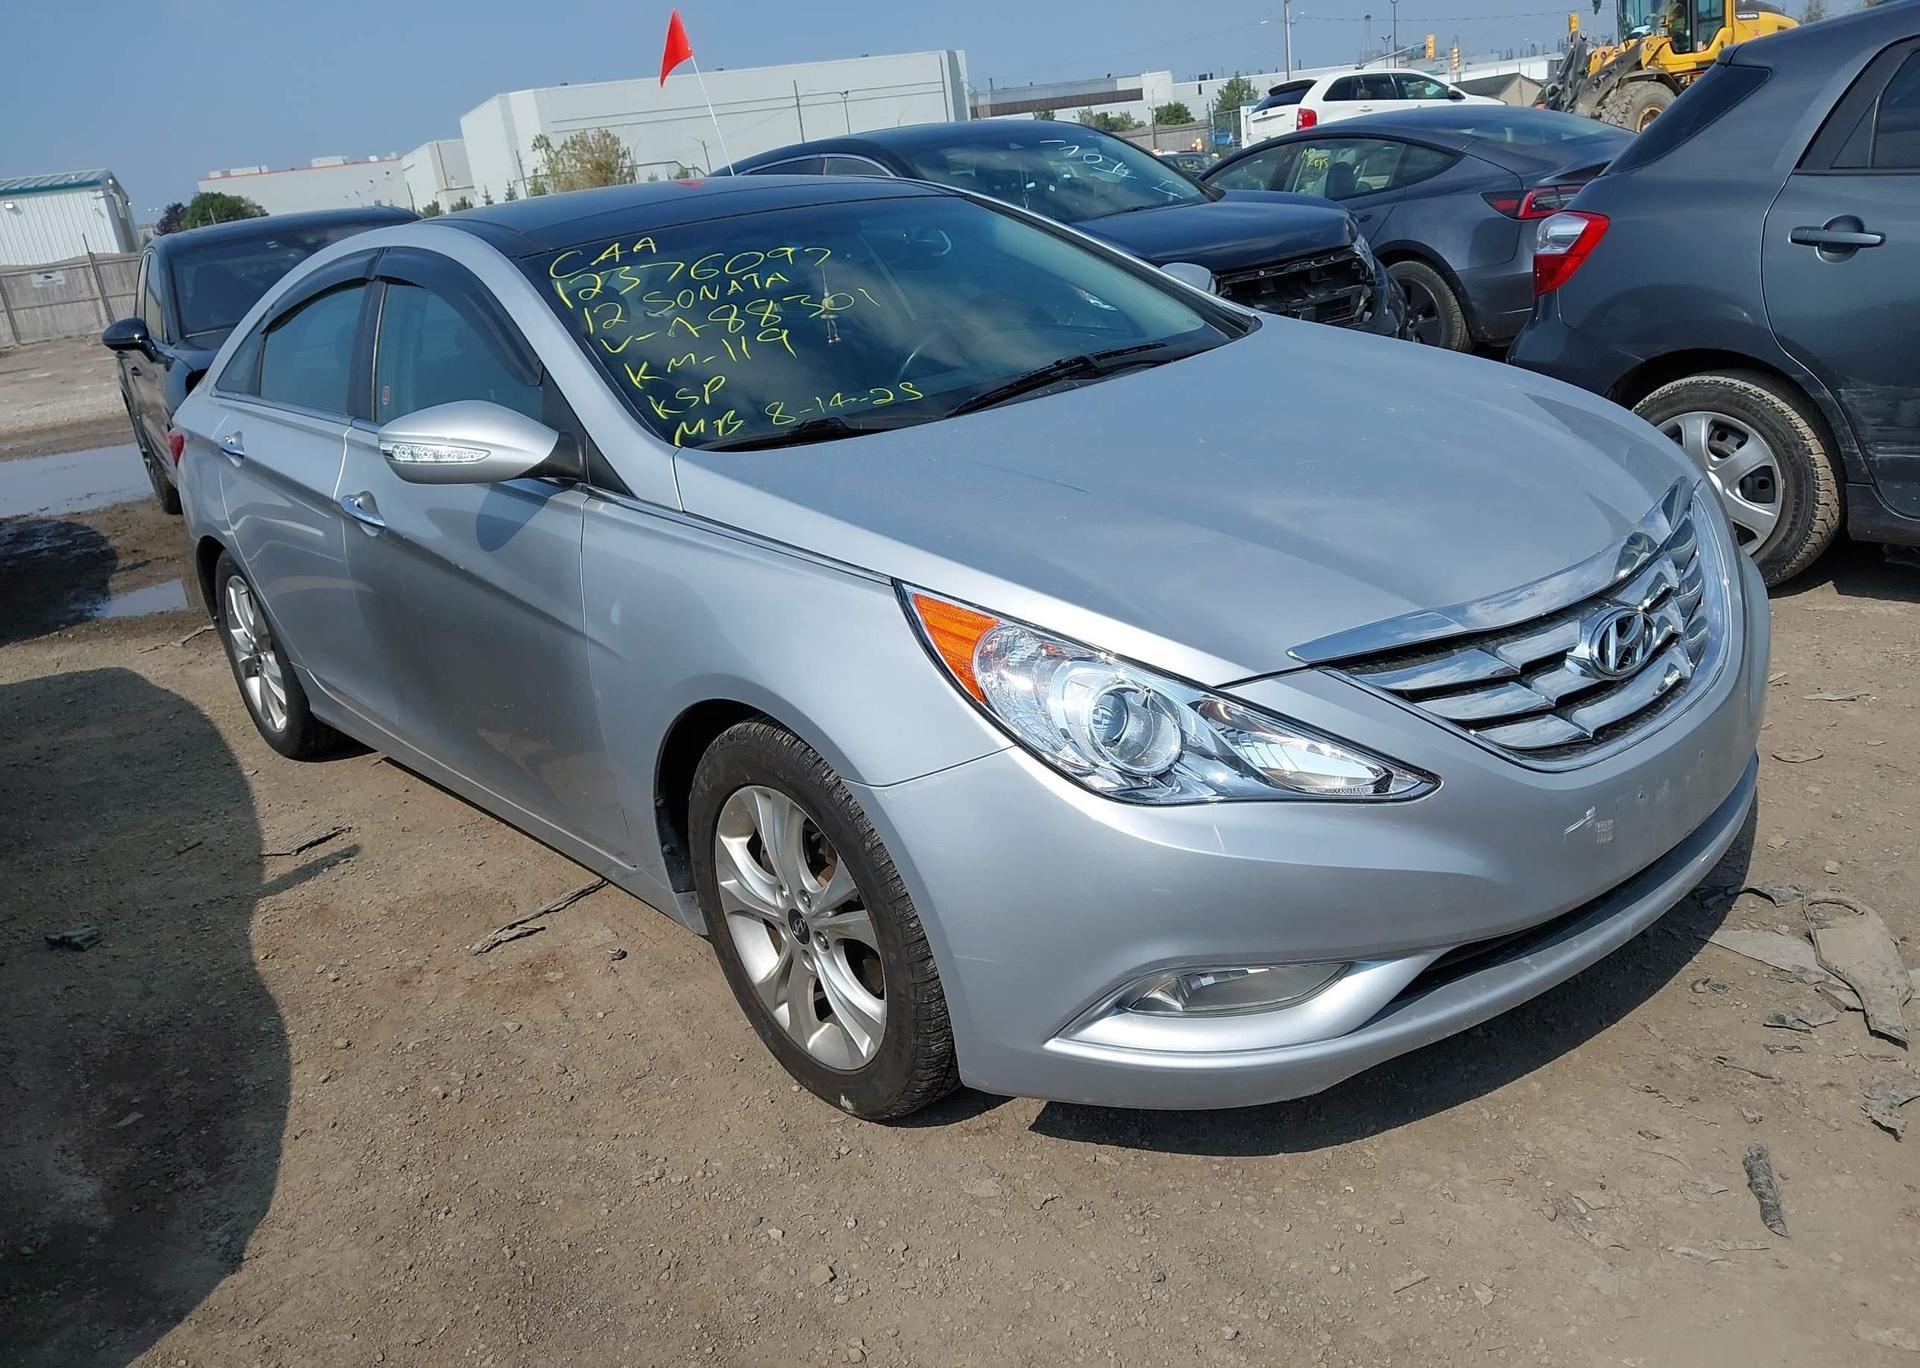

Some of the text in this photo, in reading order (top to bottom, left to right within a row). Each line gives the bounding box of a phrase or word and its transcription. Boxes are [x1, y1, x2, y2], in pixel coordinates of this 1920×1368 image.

[549, 236, 657, 279] CAA
[583, 271, 790, 335] 12 SONATA
[646, 374, 727, 421] KSP
